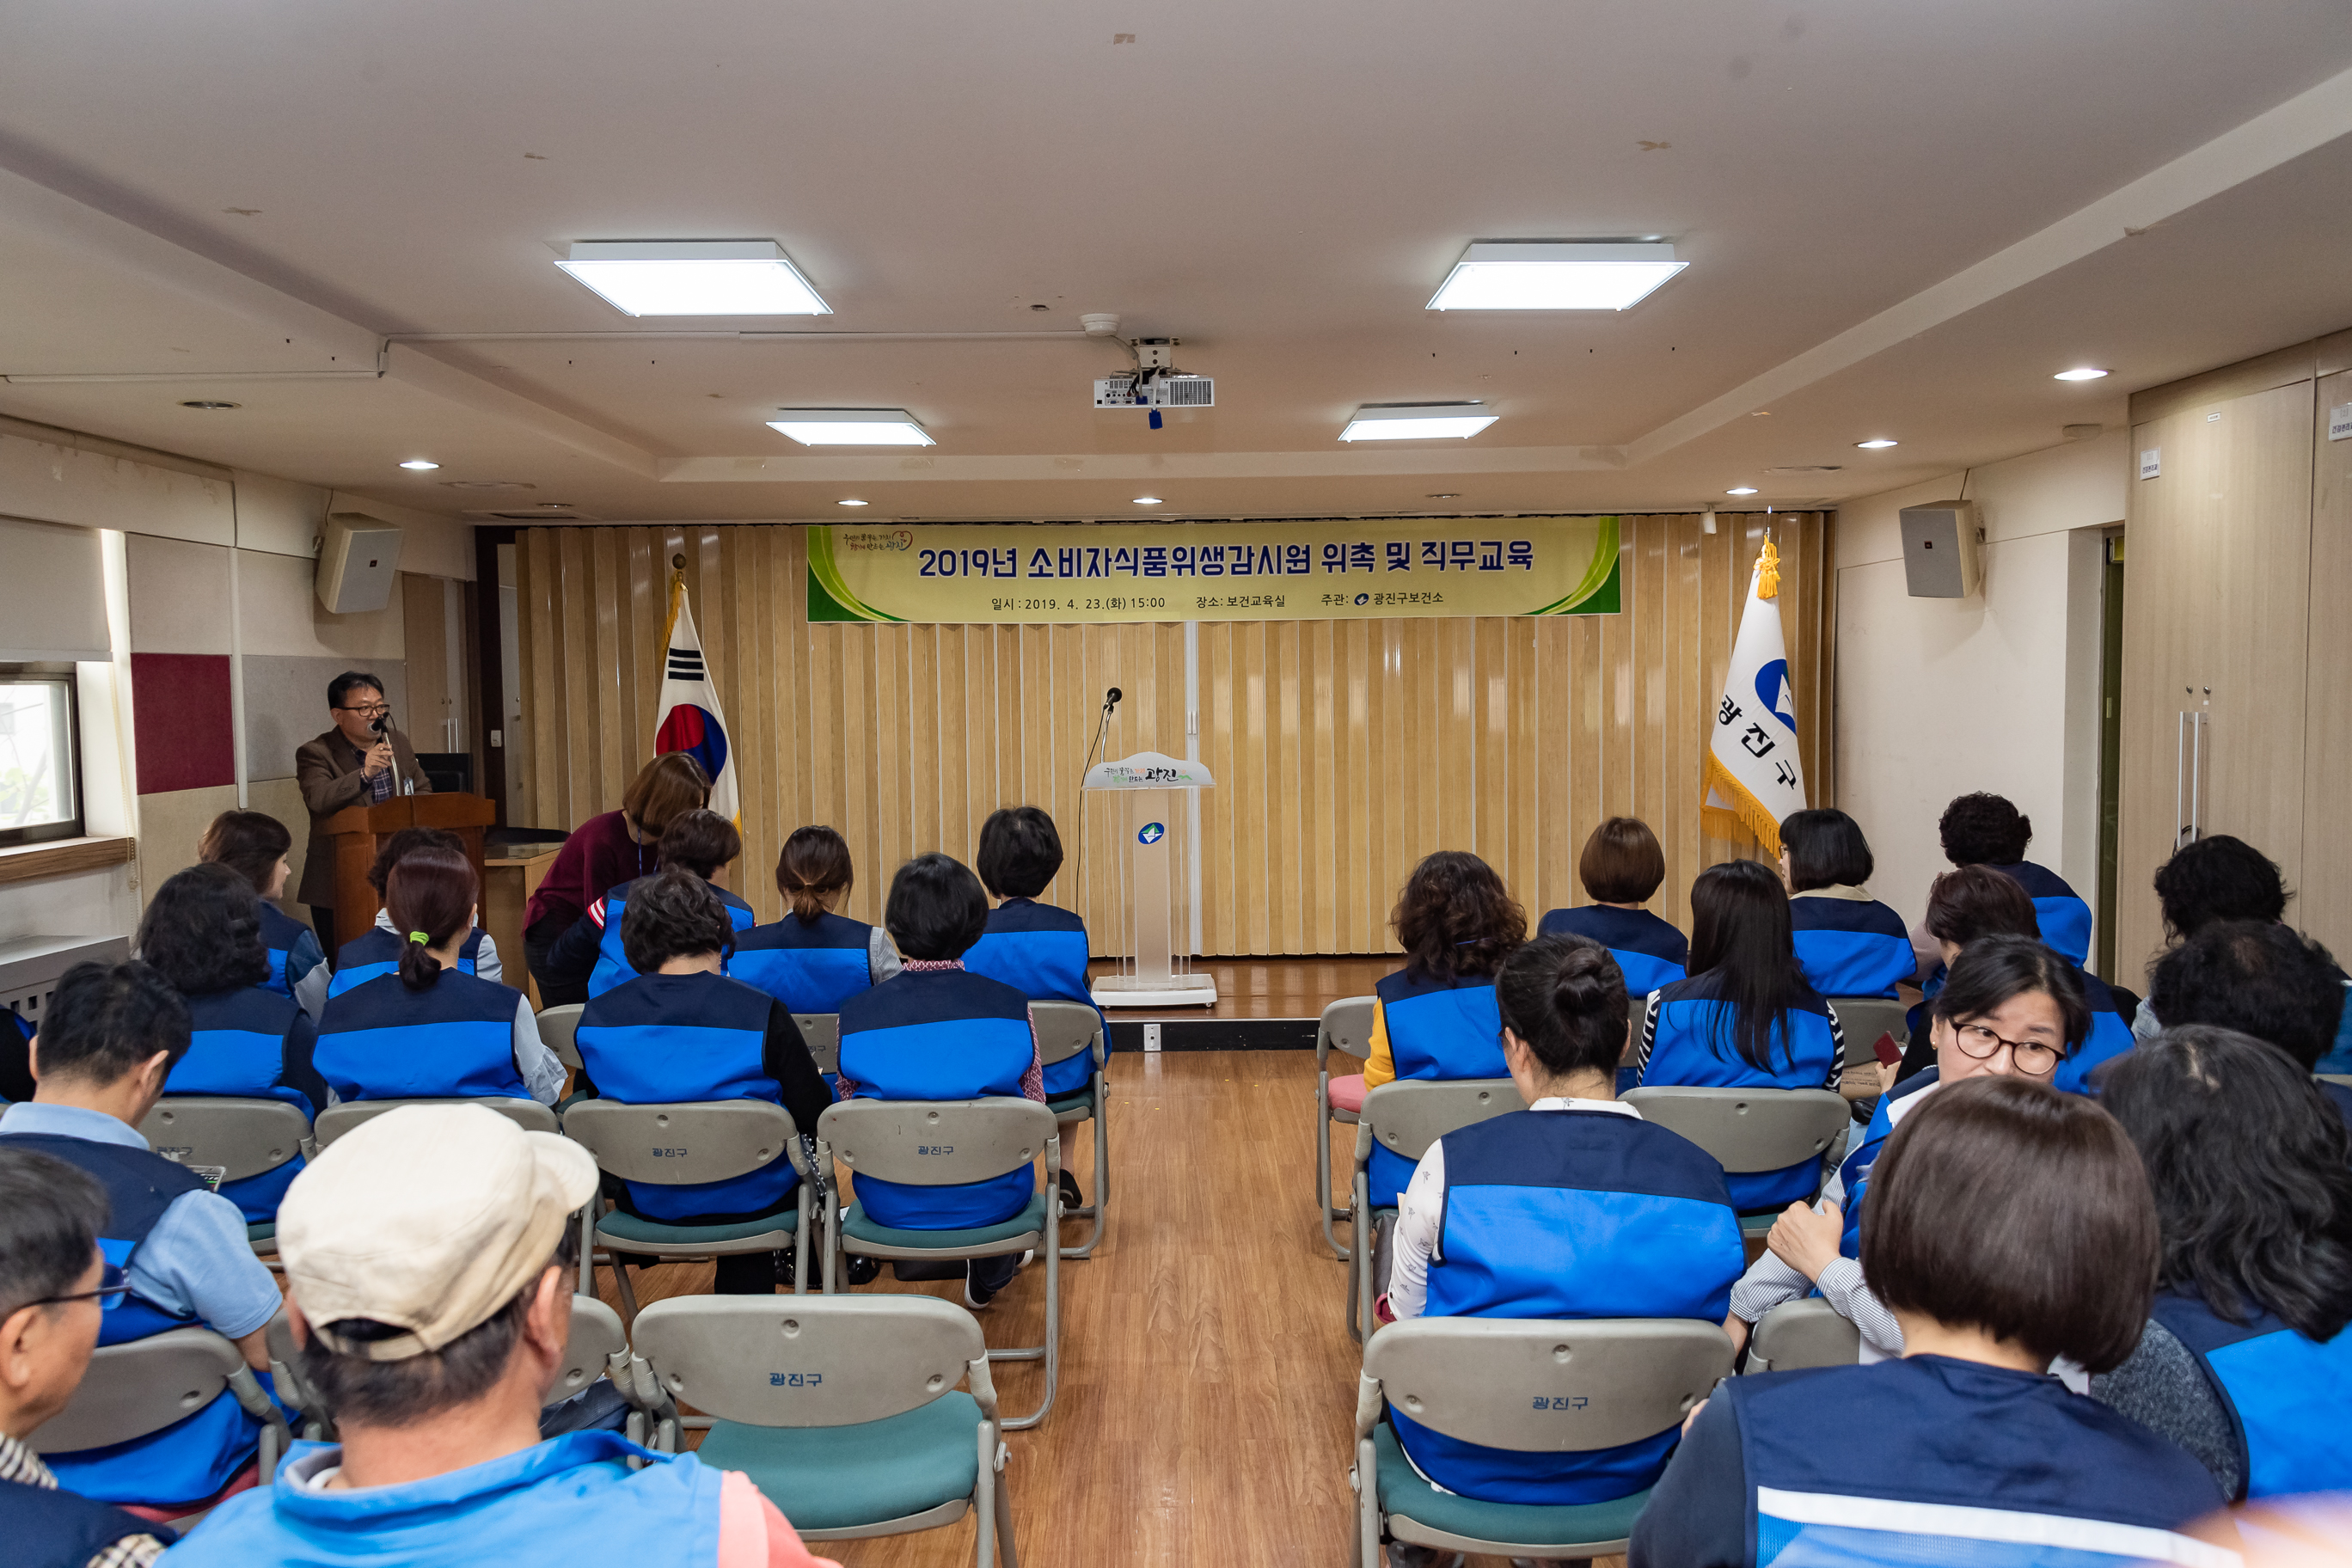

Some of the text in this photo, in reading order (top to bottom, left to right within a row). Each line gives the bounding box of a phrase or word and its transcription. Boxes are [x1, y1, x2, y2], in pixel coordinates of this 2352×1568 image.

[919, 541, 1534, 578] 2019년 소비자식품위생감시원 위촉 및 직무교육
[1026, 598, 1060, 609] 2019.
[1067, 598, 1078, 609] 4.
[1131, 597, 1165, 609] 15:00
[1197, 595, 1286, 609] 장소: 보건교육실
[1320, 591, 1444, 607] 주관: 광진구보건소
[1719, 694, 1797, 790] 광진구
[1145, 767, 1179, 782] 광진
[652, 1148, 688, 1158] 광진구
[918, 1145, 954, 1155] 광진구
[769, 1372, 823, 1387] 광진구
[1533, 1396, 1589, 1411] 광진구
